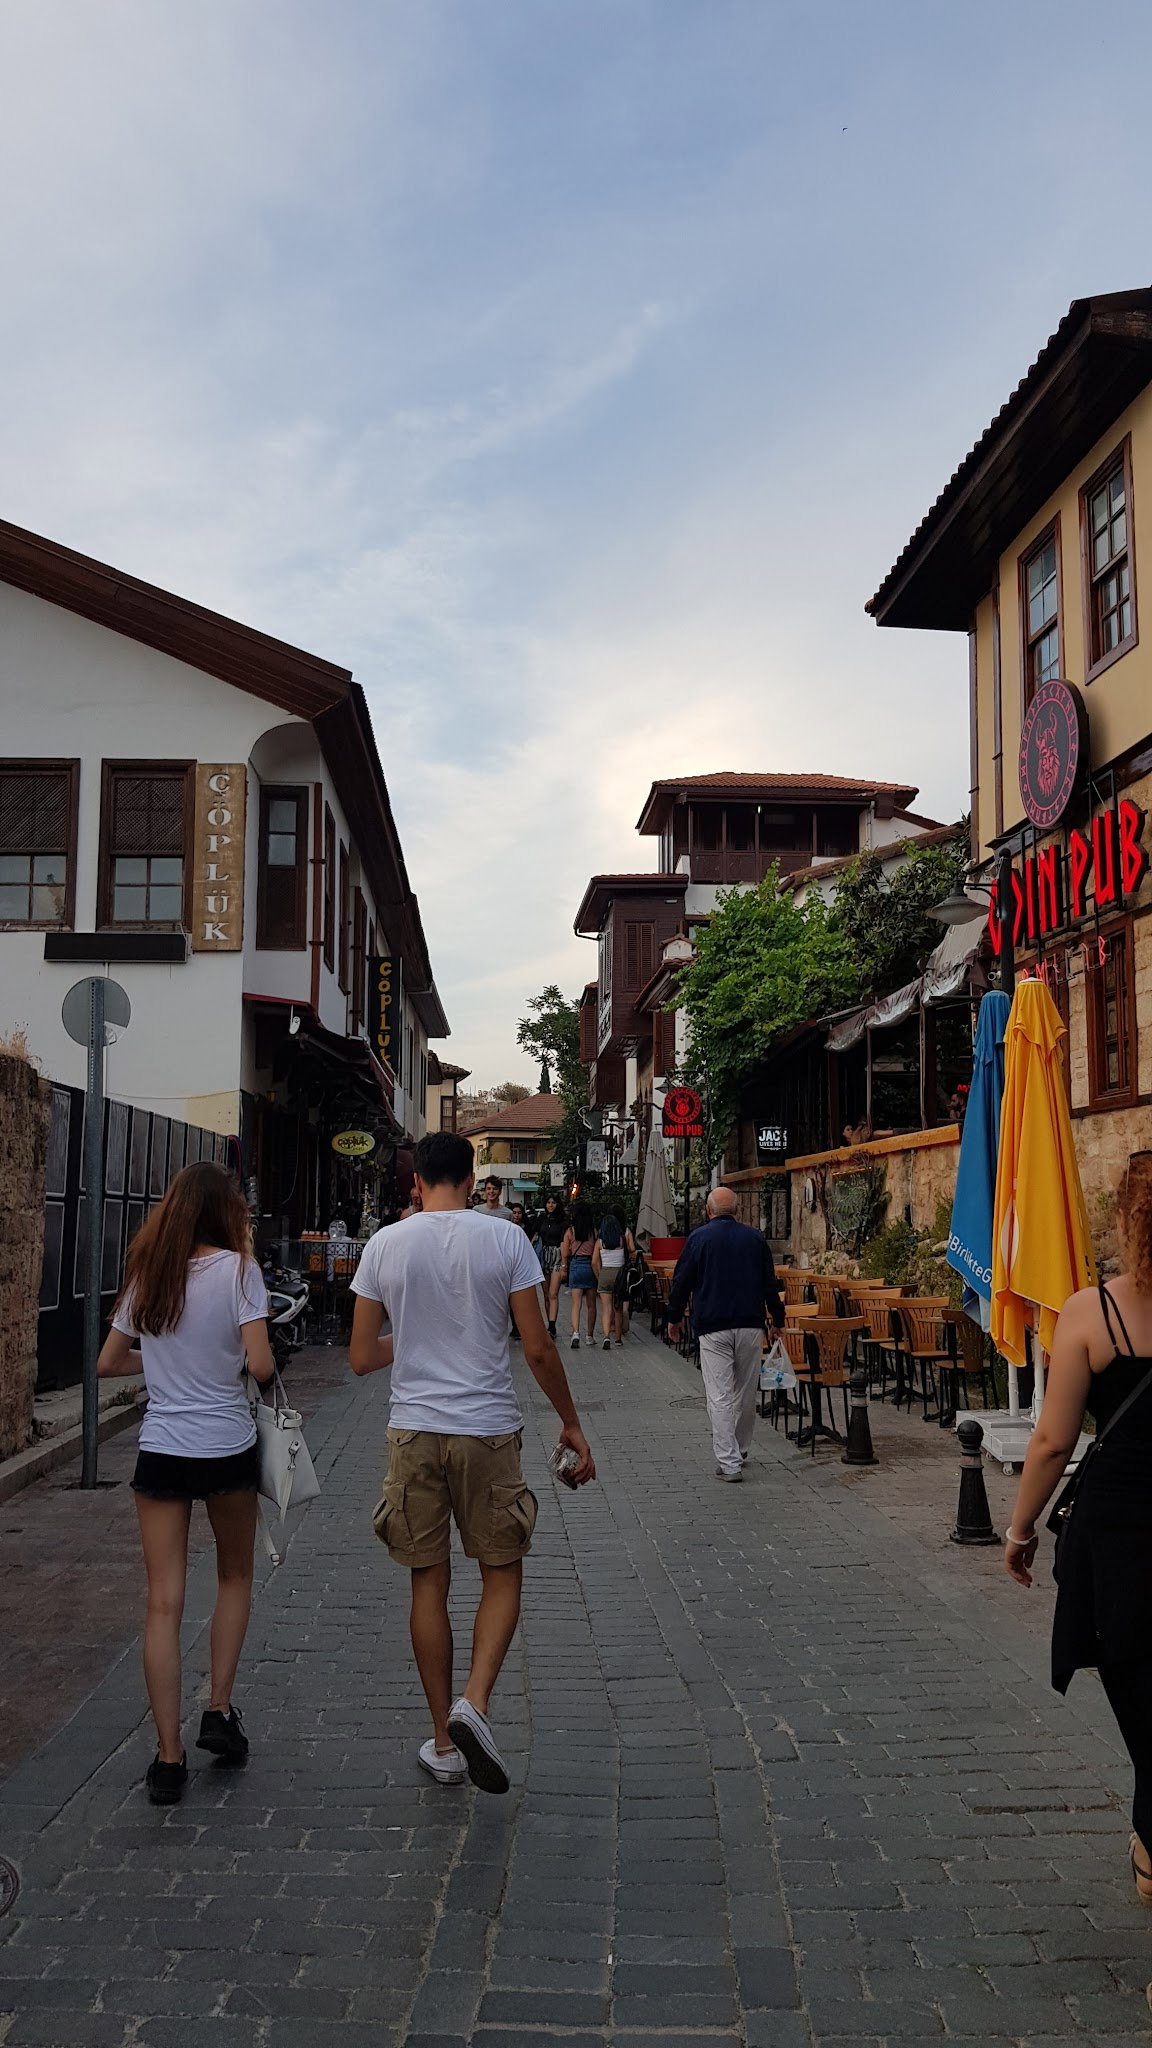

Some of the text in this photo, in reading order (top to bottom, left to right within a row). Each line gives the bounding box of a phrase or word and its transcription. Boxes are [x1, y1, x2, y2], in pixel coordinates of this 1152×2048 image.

[202, 774, 233, 942] ÇÖPLÜK
[1070, 799, 1143, 918] PUB
[664, 1124, 703, 1136] ODIN PUB
